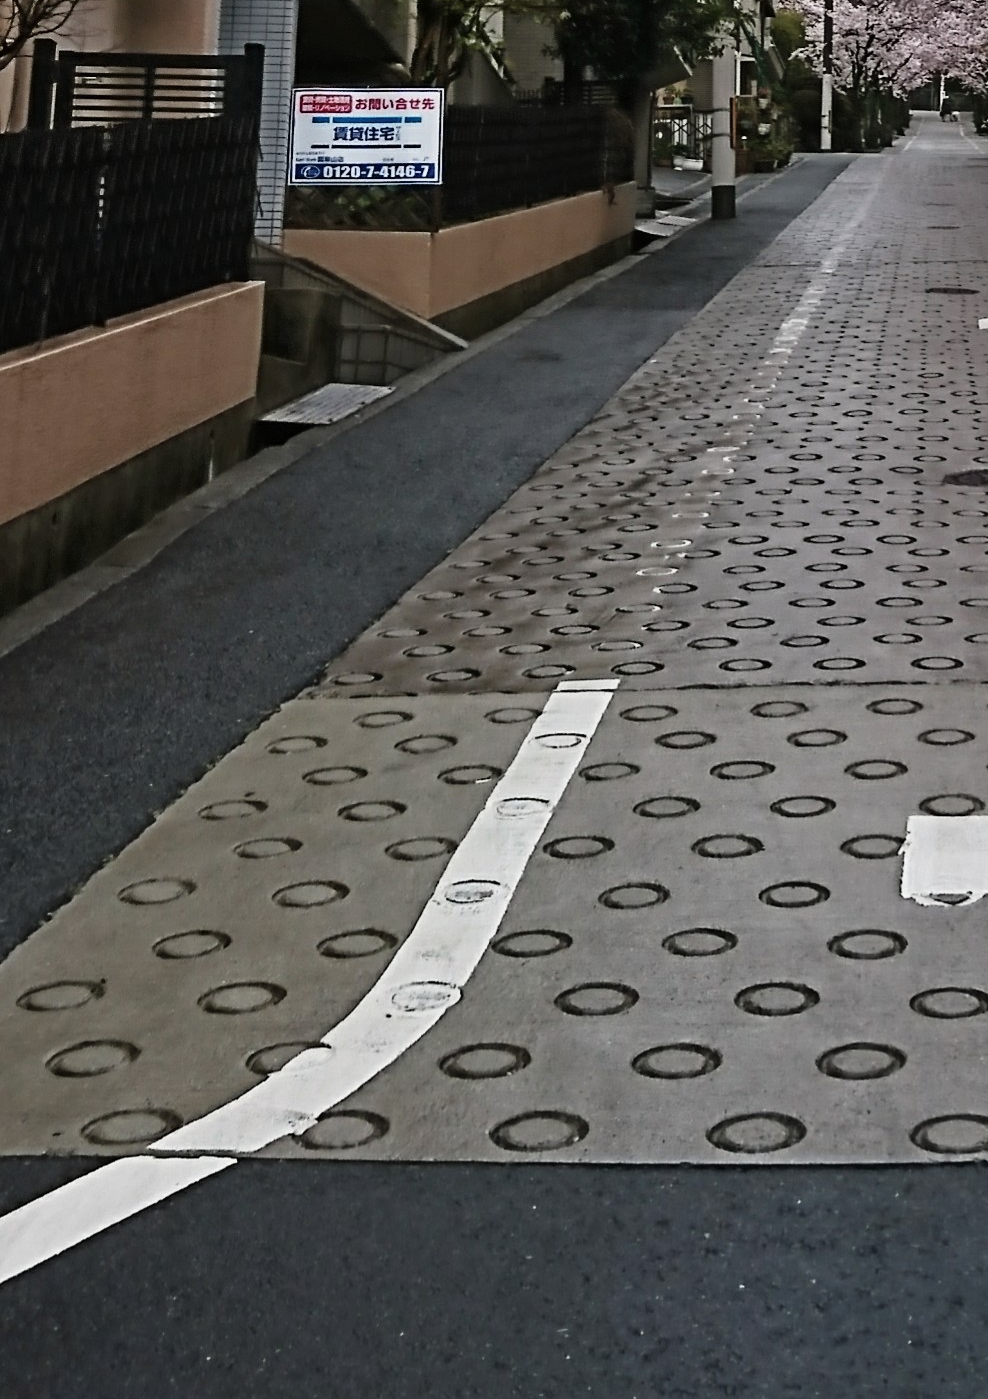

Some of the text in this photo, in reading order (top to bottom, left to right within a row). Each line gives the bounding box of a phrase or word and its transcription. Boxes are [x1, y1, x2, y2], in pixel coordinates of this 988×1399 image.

[355, 98, 435, 111] お問い合せ先
[332, 126, 395, 142] 賃貸住宅
[323, 165, 430, 179] 0120-7-4146-7
